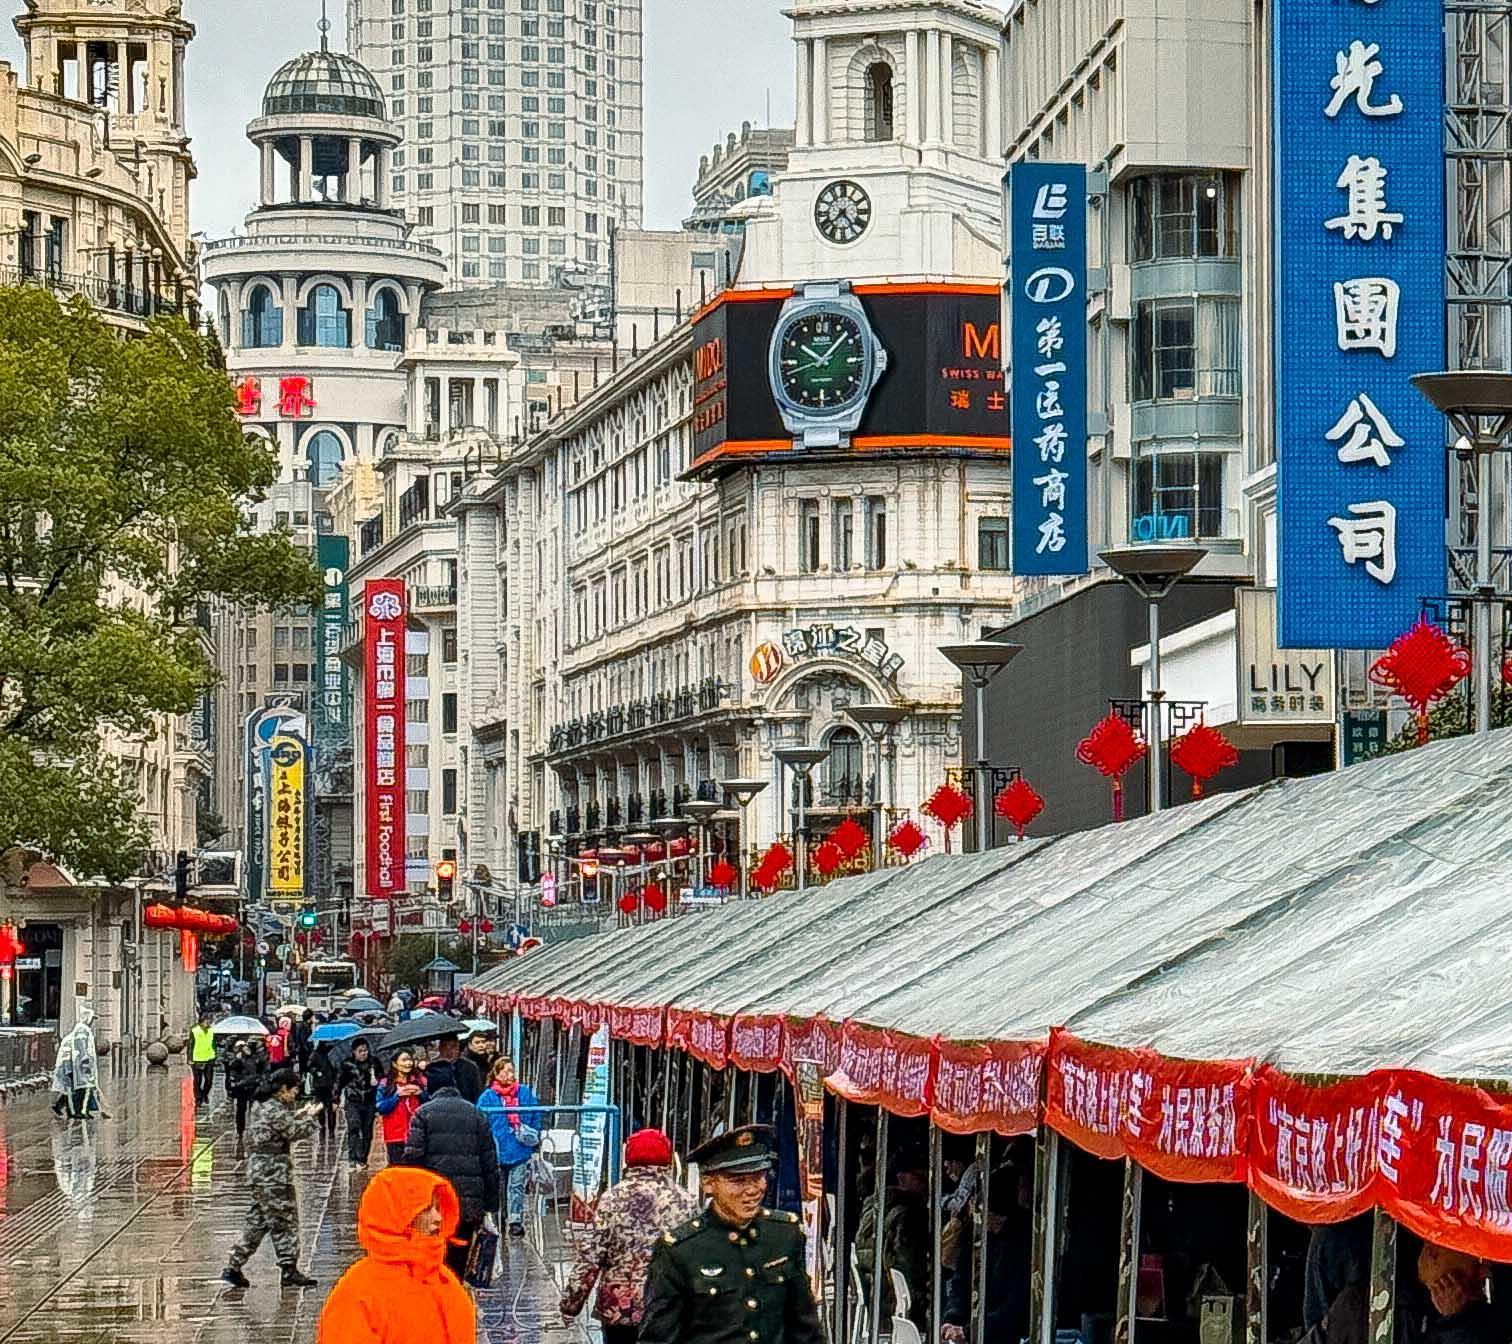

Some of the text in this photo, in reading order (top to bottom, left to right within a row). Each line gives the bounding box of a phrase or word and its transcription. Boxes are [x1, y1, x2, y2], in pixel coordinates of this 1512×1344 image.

[941, 367, 980, 380] SWISS
[1032, 315, 1069, 555] 第一医药商店
[1250, 663, 1325, 692] LILY
[1250, 694, 1326, 714] 商务时装
[377, 824, 394, 889] Foodhall
